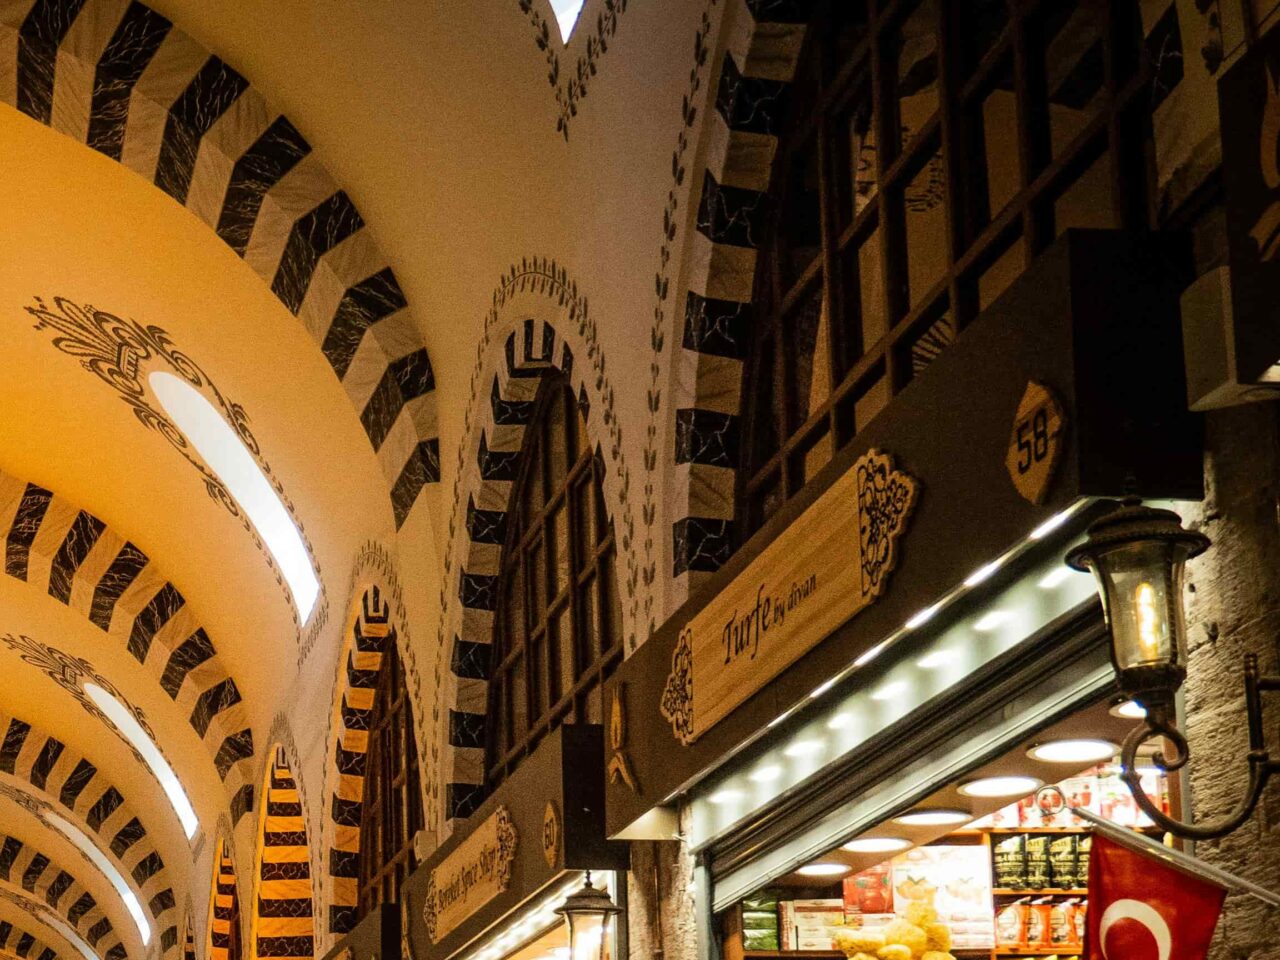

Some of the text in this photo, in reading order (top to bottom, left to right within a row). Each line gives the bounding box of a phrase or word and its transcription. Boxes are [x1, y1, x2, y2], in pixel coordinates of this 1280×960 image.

[1017, 407, 1047, 475] 58
[722, 574, 816, 665] Turfe by divan
